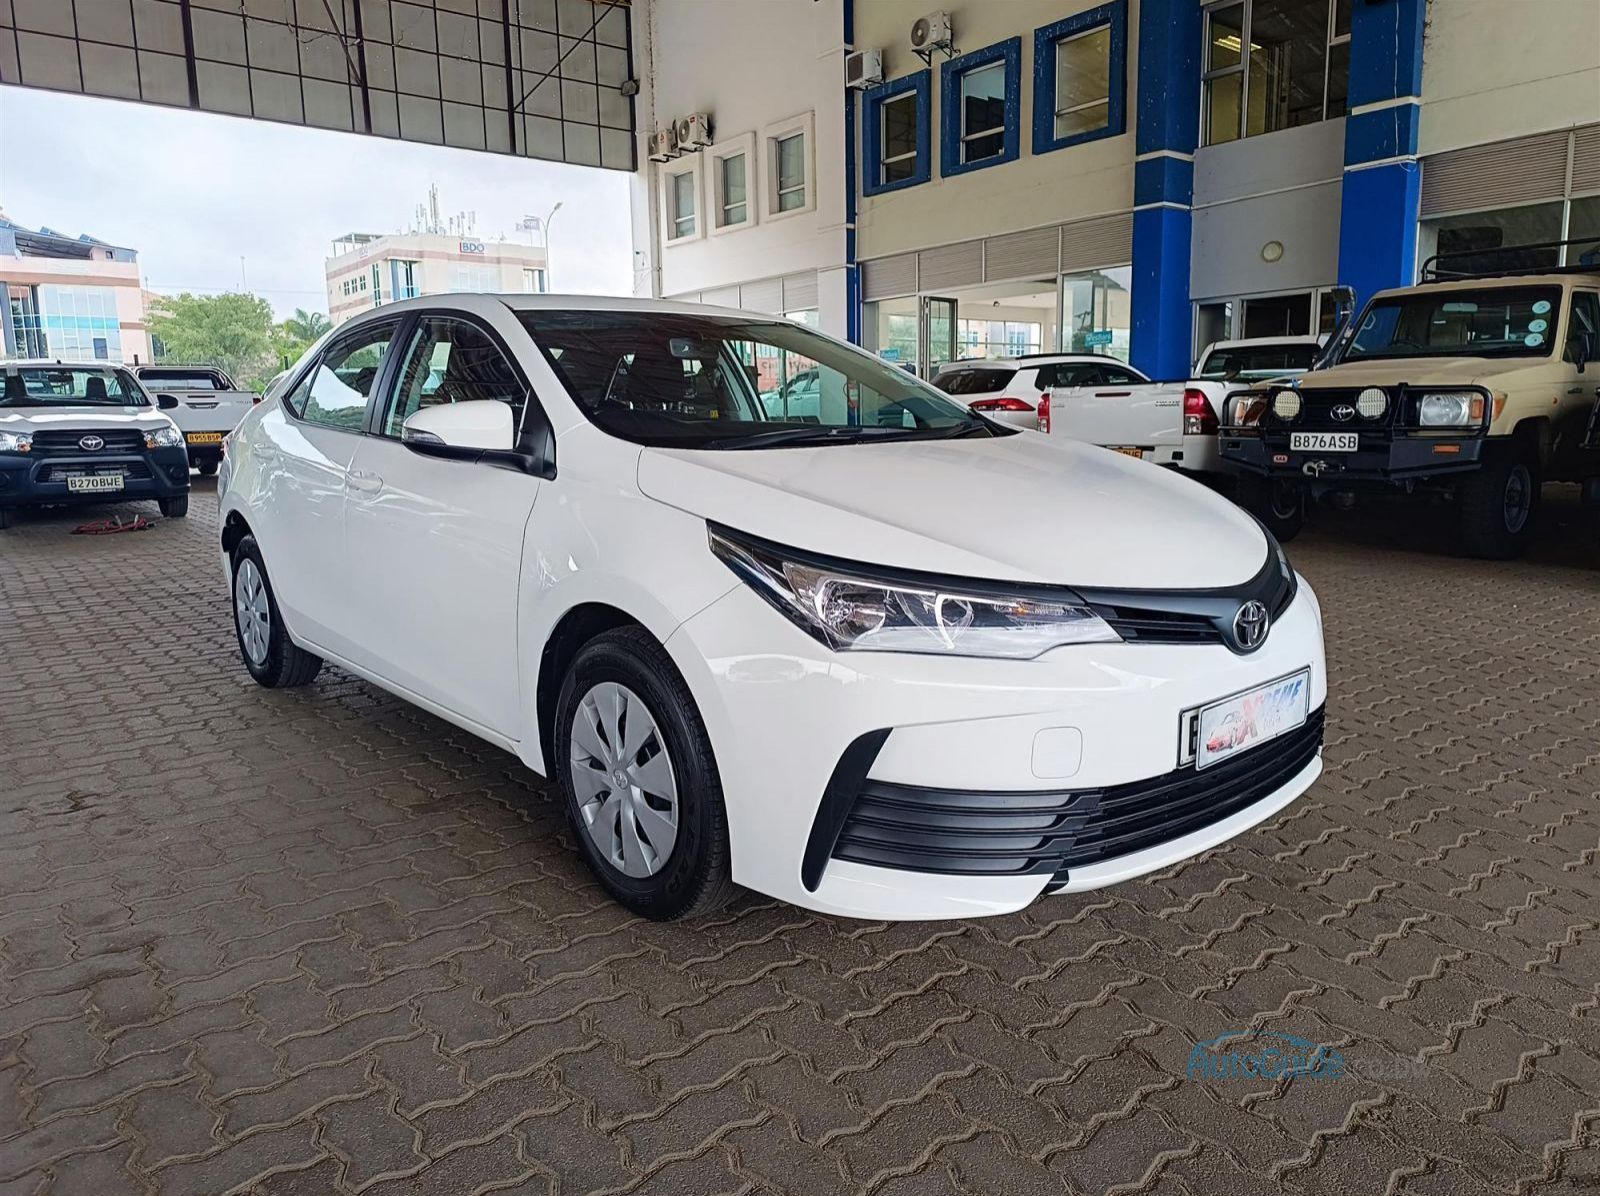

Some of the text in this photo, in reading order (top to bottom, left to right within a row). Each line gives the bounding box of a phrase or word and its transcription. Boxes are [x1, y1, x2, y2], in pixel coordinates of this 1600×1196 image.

[462, 242, 485, 252] BDO
[1293, 435, 1357, 449] B876ASB
[70, 476, 121, 488] B270BWE
